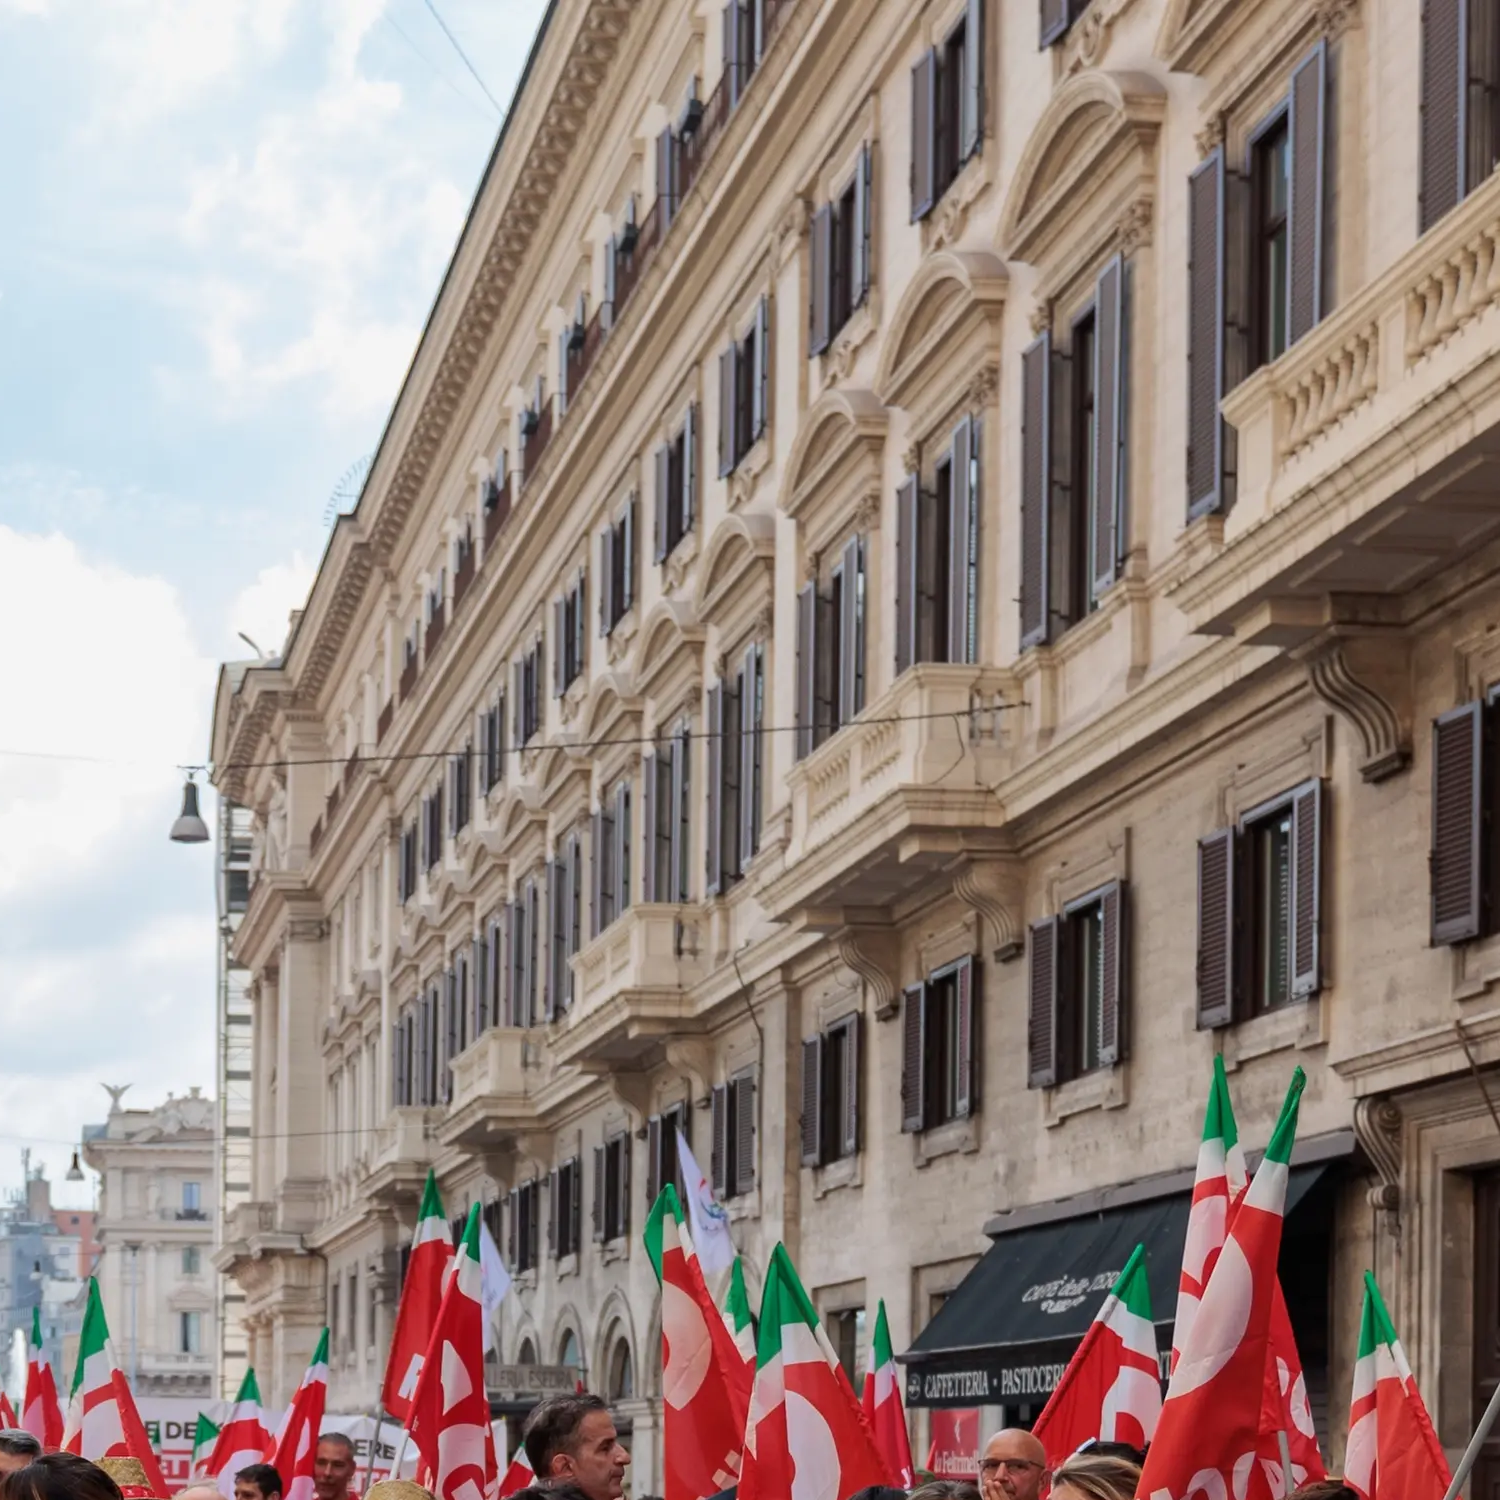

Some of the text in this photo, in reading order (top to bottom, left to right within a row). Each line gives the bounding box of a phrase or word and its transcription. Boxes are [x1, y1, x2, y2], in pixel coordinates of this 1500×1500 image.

[924, 1370, 989, 1399] CAFFETTERIA
[1001, 1361, 1070, 1395] PASTICCERI
[942, 1449, 980, 1474] Feltrinell
